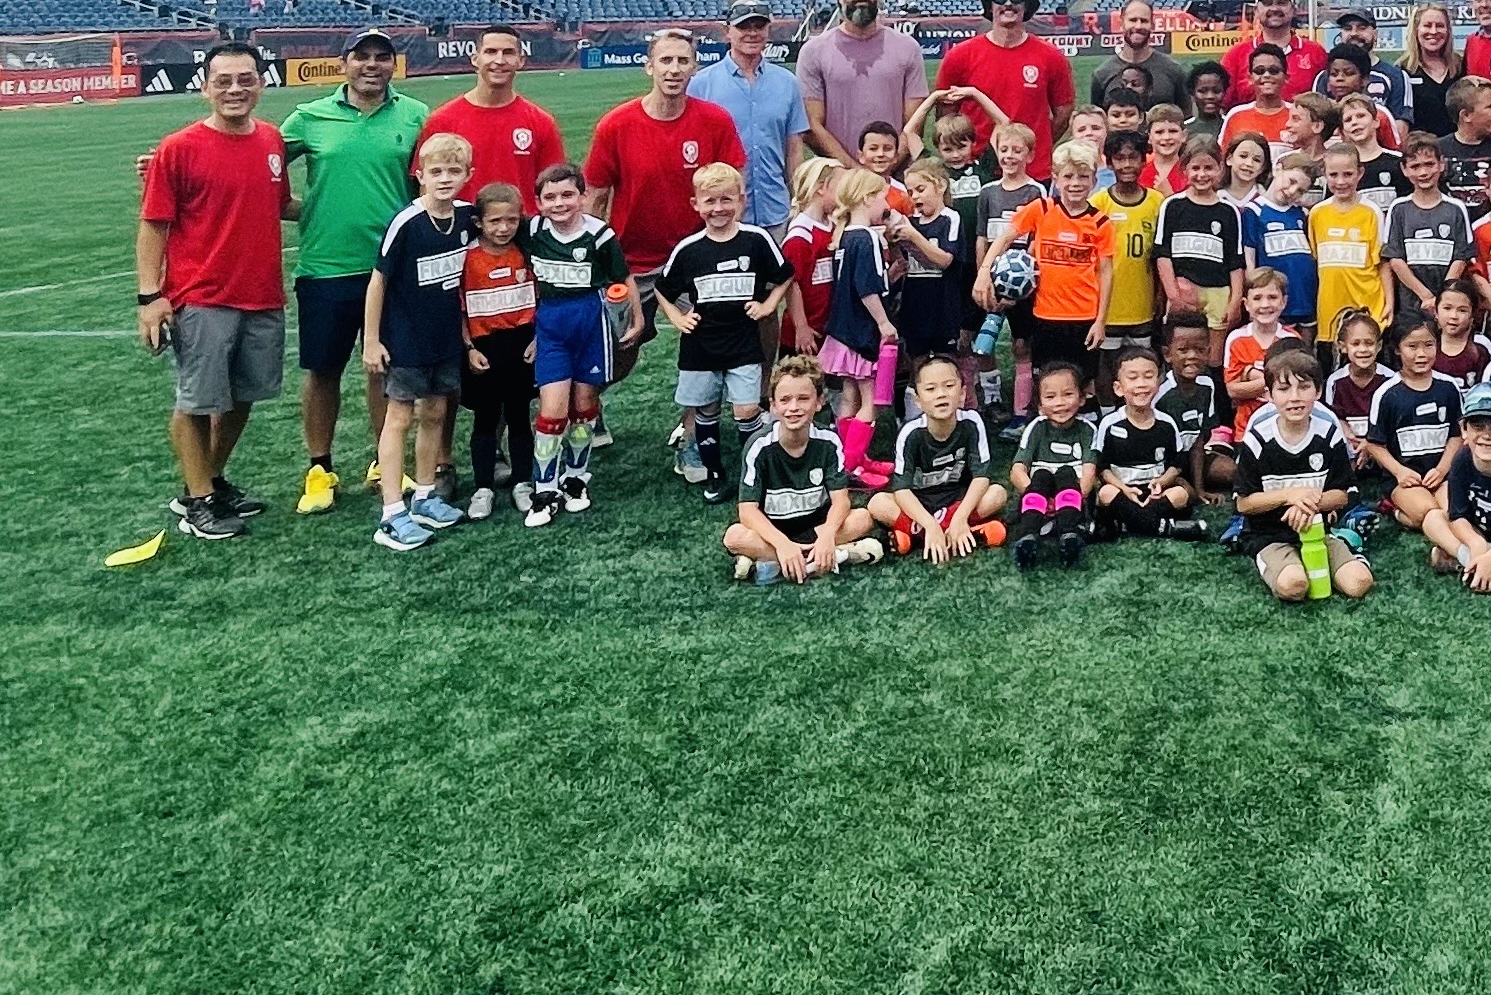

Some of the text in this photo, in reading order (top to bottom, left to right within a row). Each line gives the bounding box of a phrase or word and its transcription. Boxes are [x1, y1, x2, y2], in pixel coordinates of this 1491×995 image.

[604, 53, 634, 65] Mass
[17, 81, 27, 95] A
[28, 77, 82, 94] SEASON
[1127, 233, 1143, 258] 10
